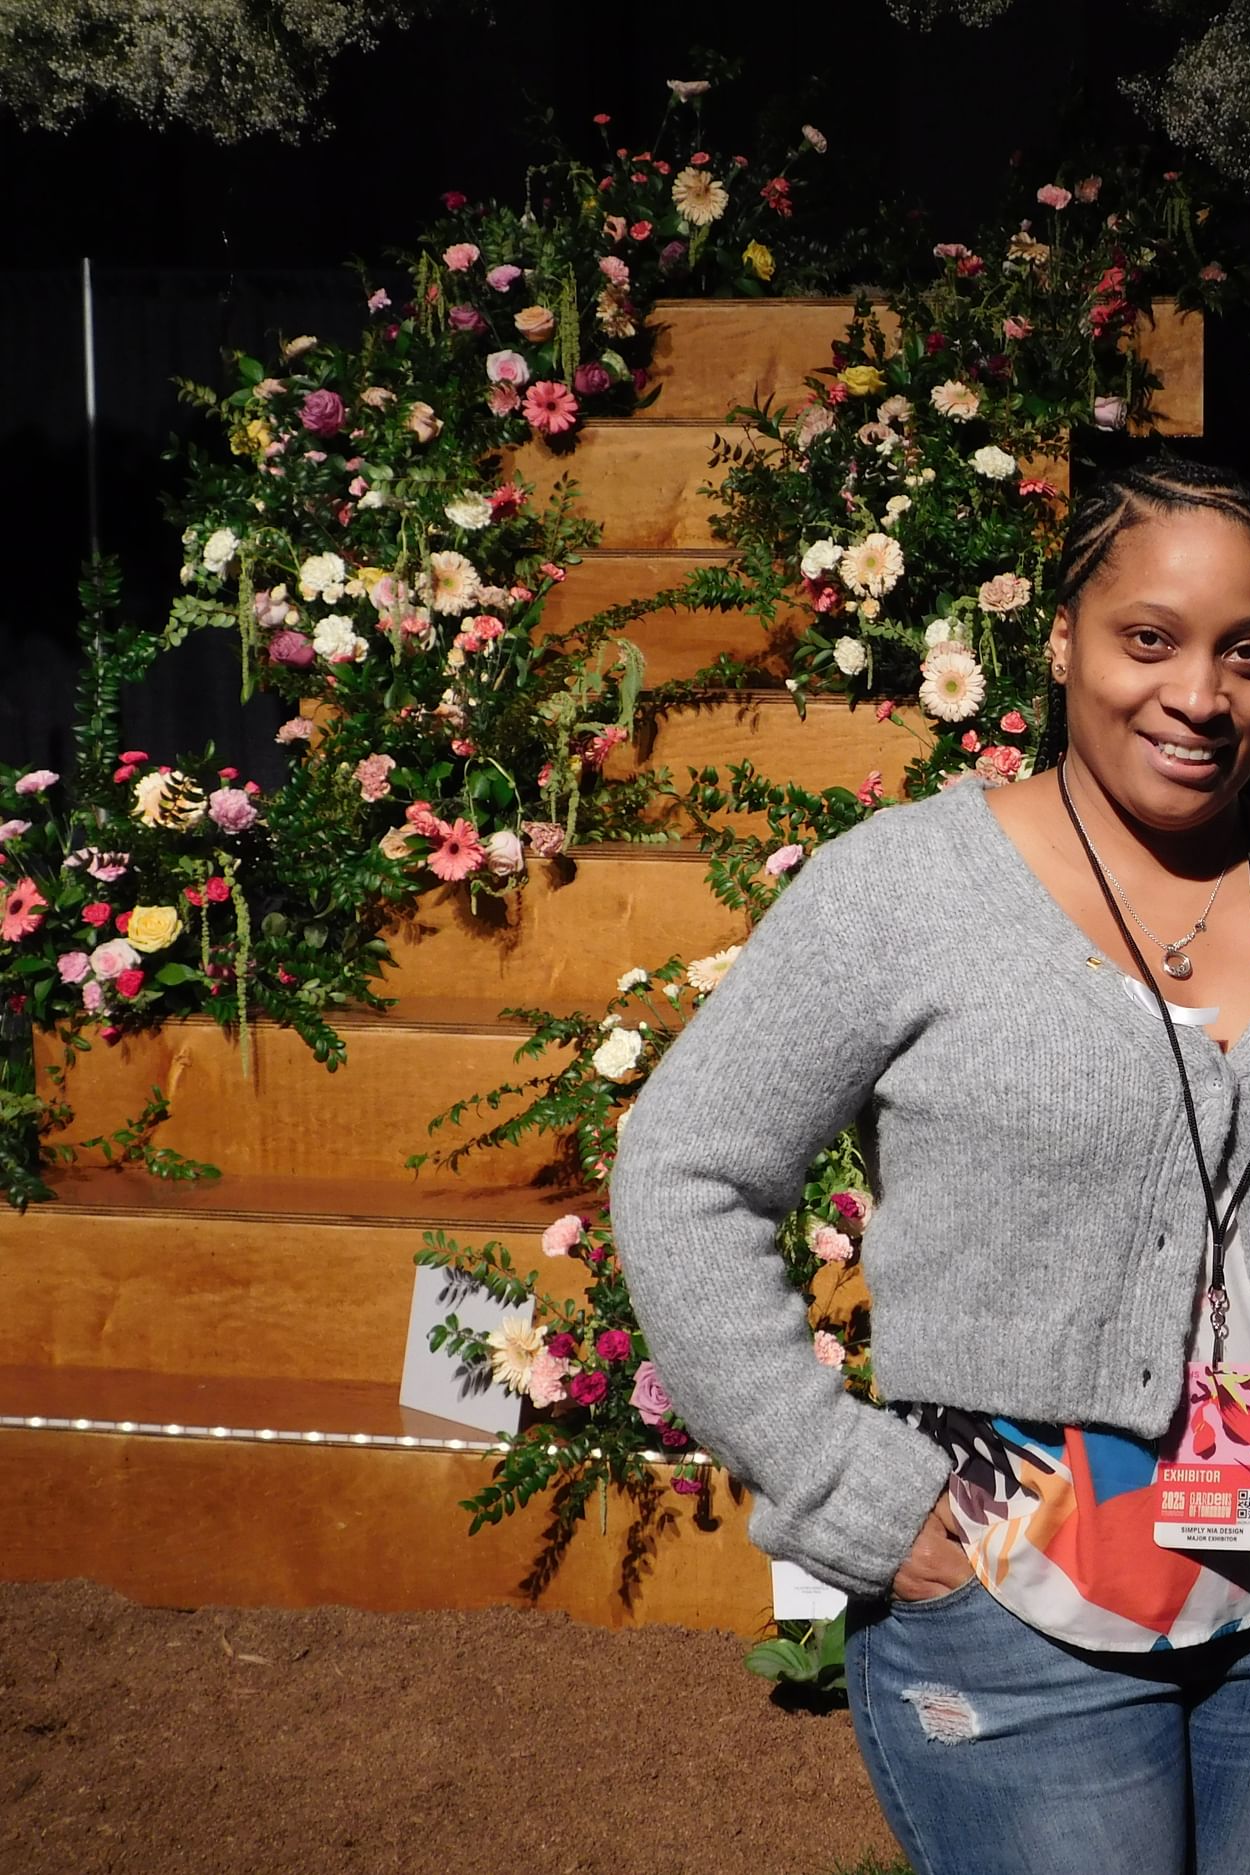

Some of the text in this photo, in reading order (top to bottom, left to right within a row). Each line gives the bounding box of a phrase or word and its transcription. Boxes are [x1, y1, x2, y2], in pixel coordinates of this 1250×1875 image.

[1163, 1469, 1221, 1483] EXHIBITOR
[1162, 1491, 1185, 1510] 2025
[1181, 1526, 1205, 1534] SIMPLY
[1220, 1527, 1244, 1535] DESIGN
